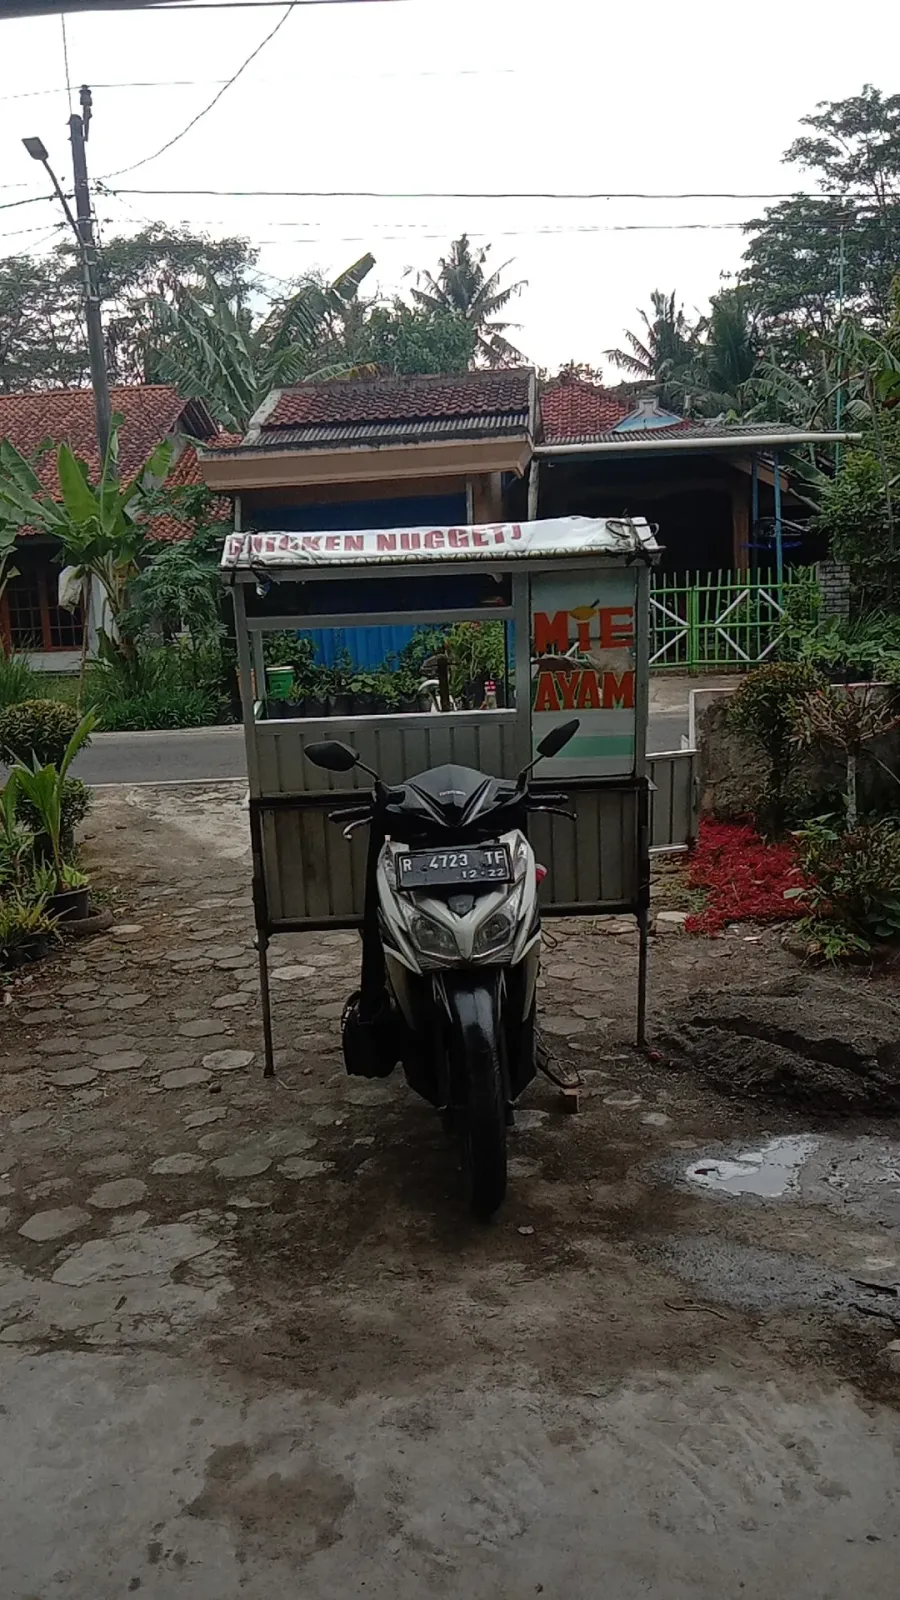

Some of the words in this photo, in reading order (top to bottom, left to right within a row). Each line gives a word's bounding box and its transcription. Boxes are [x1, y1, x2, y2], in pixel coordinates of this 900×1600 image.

[533, 669, 636, 712] AYAM
[402, 858, 412, 872] R
[429, 853, 468, 869] 4723
[484, 850, 505, 865] TF
